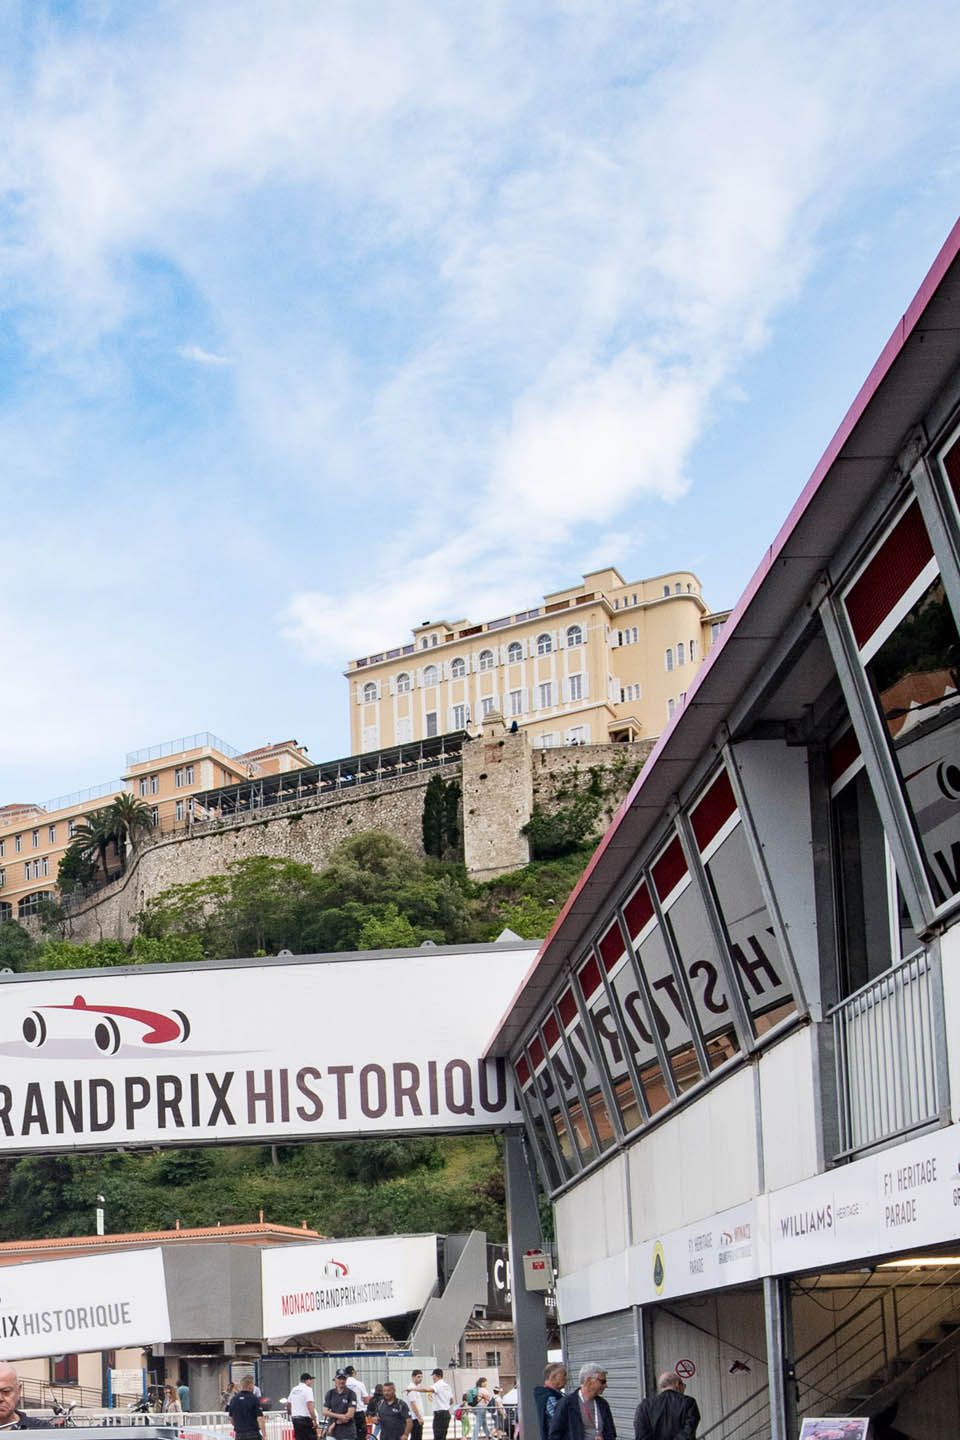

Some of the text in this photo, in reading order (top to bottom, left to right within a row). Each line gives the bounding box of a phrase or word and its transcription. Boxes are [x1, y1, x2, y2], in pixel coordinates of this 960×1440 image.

[246, 1057, 522, 1124] HISTORIQU
[897, 1158, 937, 1191] HERITAGE
[780, 1205, 833, 1239] WILLIAMS
[885, 1199, 917, 1228] PARADE
